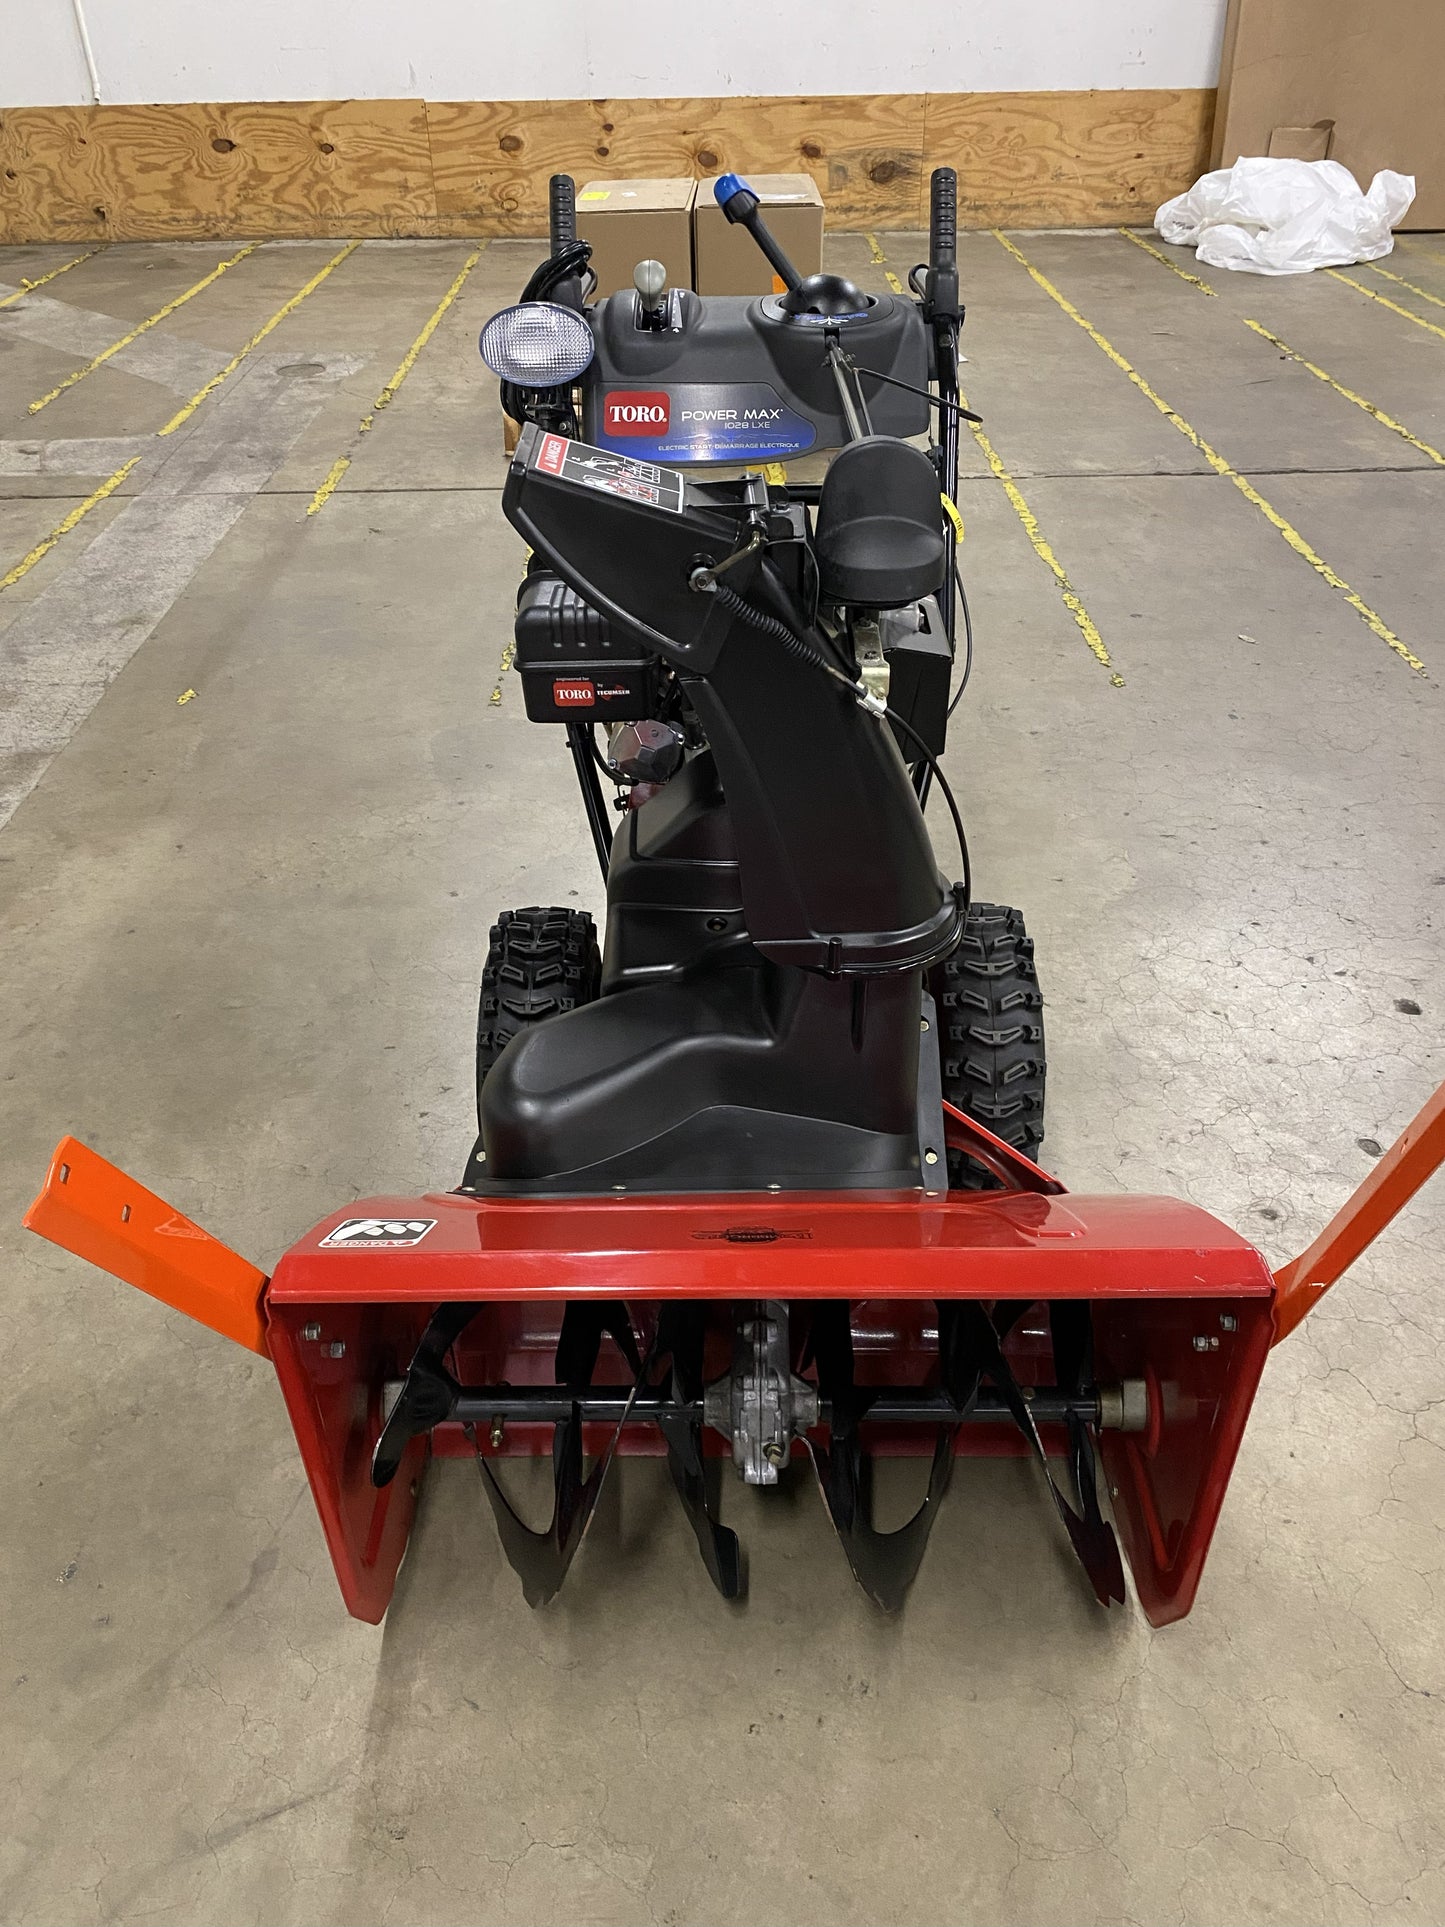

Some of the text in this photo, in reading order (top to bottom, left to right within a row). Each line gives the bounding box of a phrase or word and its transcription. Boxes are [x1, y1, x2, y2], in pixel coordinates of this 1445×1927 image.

[681, 408, 781, 422] POWER MAX
[725, 421, 771, 429] 1028 LXE
[557, 690, 591, 699] TORO
